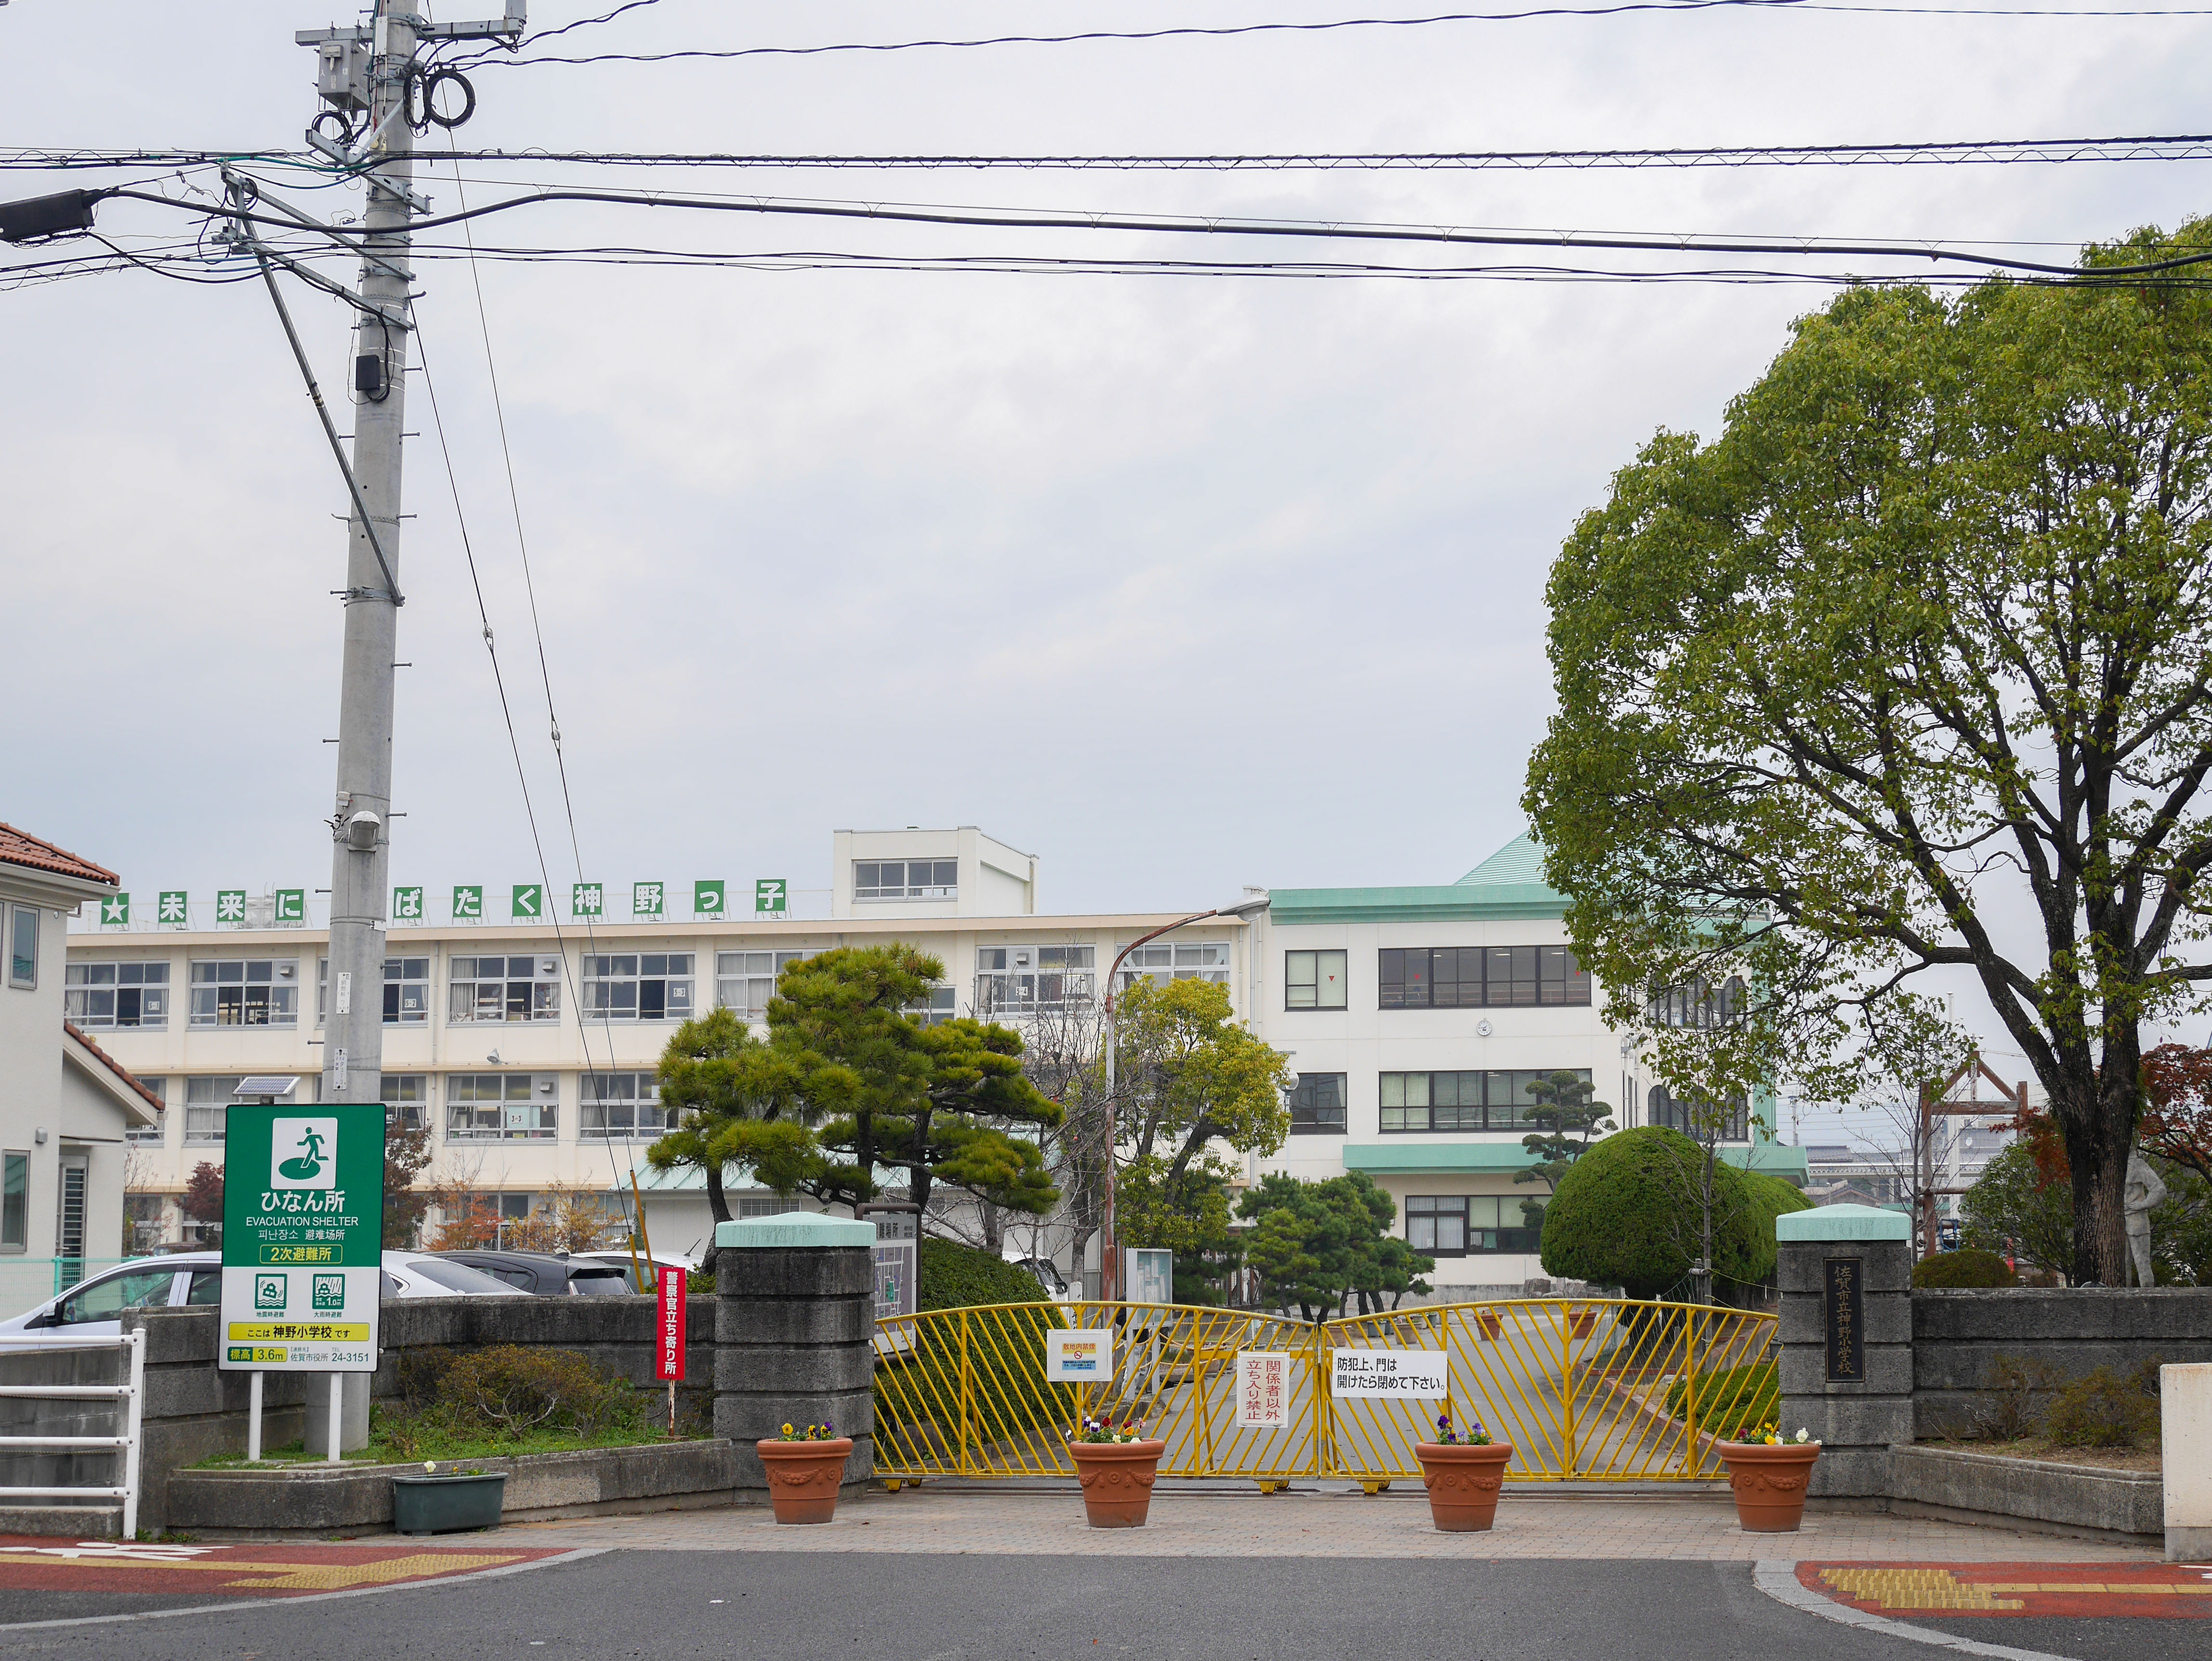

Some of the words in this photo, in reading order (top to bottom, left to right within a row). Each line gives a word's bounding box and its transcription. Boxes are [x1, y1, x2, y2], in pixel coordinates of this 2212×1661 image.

[159, 882, 785, 921] 未来にばたく神野っ子
[261, 1190, 345, 1213] ひなん所
[246, 1217, 310, 1226] EVACUATION
[312, 1216, 359, 1226] SHELTER
[258, 1229, 299, 1240] 피난장소
[305, 1229, 345, 1240] 避难场所
[270, 1246, 332, 1262] 2次避難所
[665, 1271, 678, 1375] 警察官立ち寄り所
[1834, 1265, 1855, 1374] 佐賀市立神野小学校
[230, 1349, 250, 1360] 標高
[258, 1349, 283, 1360] 3.6m
[290, 1353, 328, 1362] 佐賀市役所
[331, 1353, 369, 1362] 24-3151
[1337, 1357, 1397, 1372] 防犯上、門は
[1245, 1360, 1262, 1420] 立ち入り禁止
[1337, 1375, 1445, 1390] 開けたら閉めて下さい。
[1265, 1360, 1281, 1421] 関係者以外
